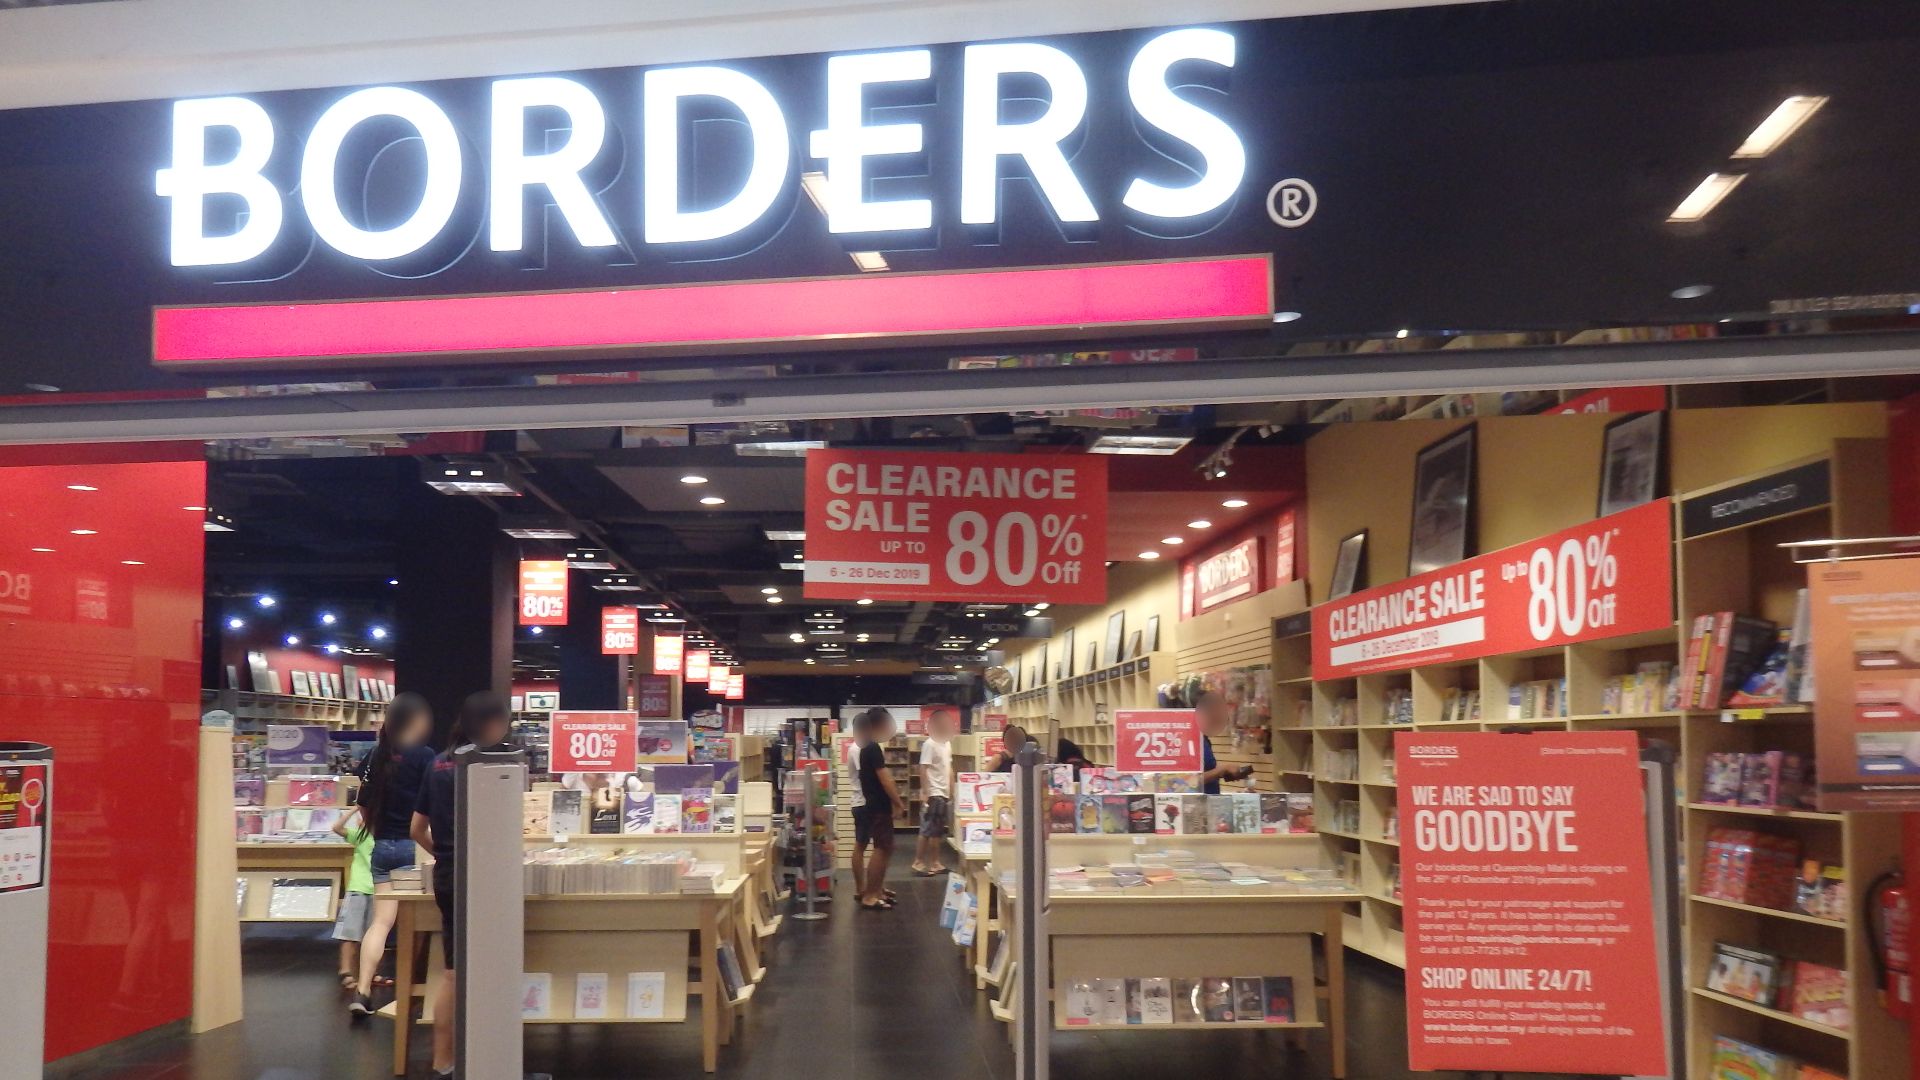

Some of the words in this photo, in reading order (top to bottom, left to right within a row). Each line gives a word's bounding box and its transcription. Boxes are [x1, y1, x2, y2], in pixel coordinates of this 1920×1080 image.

[155, 27, 1247, 268] BORDERS
[826, 463, 1076, 499] CLEARANCE
[825, 500, 930, 533] SALE
[880, 541, 900, 553] UP
[902, 541, 925, 554] TO
[945, 510, 1084, 587] 80%
[830, 568, 837, 578] 6
[849, 568, 864, 579] 26
[867, 568, 890, 579] Dec
[893, 569, 920, 580] 2019
[1041, 561, 1081, 584] Off
[1501, 563, 1515, 583] Up
[1515, 560, 1528, 577] to
[1528, 530, 1618, 642] 80%
[523, 595, 564, 618] 80%
[1329, 585, 1427, 642] CLEARANCE
[1429, 569, 1485, 617] SALE
[1587, 594, 1617, 629] Off
[1382, 635, 1420, 655] December
[569, 732, 617, 758] 80%
[601, 749, 616, 757] Off
[1134, 731, 1182, 758] 25%
[1409, 745, 1458, 755] BORDERS
[1411, 786, 1438, 806] WE
[1442, 786, 1475, 806] ARE
[1478, 786, 1511, 806] SAD
[1515, 786, 1538, 806] TO
[1542, 786, 1574, 806] SAY
[1414, 809, 1578, 852] GOODBYE
[1415, 862, 1432, 872] Our
[1434, 864, 1480, 872] bookstore
[1481, 864, 1491, 873] at
[1492, 863, 1545, 875] Queensbay
[1546, 864, 1567, 873] Mall
[1568, 864, 1578, 873] is
[1579, 865, 1612, 875] closing
[1416, 874, 1431, 883] the
[1451, 874, 1461, 884] of
[1462, 875, 1510, 884] December
[1511, 875, 1536, 885] 2019
[1417, 897, 1446, 907] Thank
[1447, 900, 1466, 909] you
[1466, 899, 1479, 907] for
[1481, 900, 1502, 909] your
[1503, 900, 1551, 910] patronage
[1552, 899, 1571, 908] and
[1572, 901, 1609, 909] support
[1610, 900, 1625, 909] for
[1417, 910, 1433, 919] the
[1434, 911, 1456, 920] past
[1457, 910, 1469, 919] 12
[1508, 911, 1526, 920] has
[1527, 911, 1553, 920] been
[1562, 912, 1604, 921] pleasure
[1605, 912, 1616, 920] to
[1467, 922, 1485, 932] Any
[1487, 923, 1529, 932] enquiries
[1531, 923, 1553, 932] after
[1554, 923, 1572, 932] this
[1573, 924, 1597, 932] date
[1597, 924, 1631, 933] should
[1419, 933, 1431, 942] be
[1432, 934, 1454, 942] sent
[1454, 934, 1465, 943] to
[1466, 934, 1602, 946] enquiries@borders.com.my
[1603, 937, 1617, 945] or
[1420, 946, 1436, 954] call
[1450, 947, 1461, 955] at
[1421, 967, 1467, 989] SHOP
[1471, 968, 1534, 990] ONLINE
[1538, 969, 1592, 992] 24/7!
[1422, 998, 1441, 1007] You
[1442, 1000, 1461, 1008] can
[1461, 998, 1477, 1008] still
[1503, 1001, 1523, 1010] your
[1525, 1001, 1562, 1011] reading
[1562, 1001, 1594, 1010] needs
[1595, 1002, 1606, 1011] at
[1423, 1010, 1474, 1019] BORDERS
[1475, 1011, 1508, 1020] Online
[1540, 1012, 1566, 1022] Head
[1567, 1014, 1590, 1022] over
[1590, 1014, 1603, 1023] to
[1423, 1023, 1525, 1034] www.borders.net.my
[1526, 1025, 1546, 1034] and
[1547, 1026, 1574, 1036] enjoy
[1576, 1027, 1603, 1035] some
[1603, 1026, 1615, 1035] of
[1616, 1026, 1634, 1036] the
[1423, 1034, 1445, 1044] best
[1446, 1035, 1473, 1044] reads
